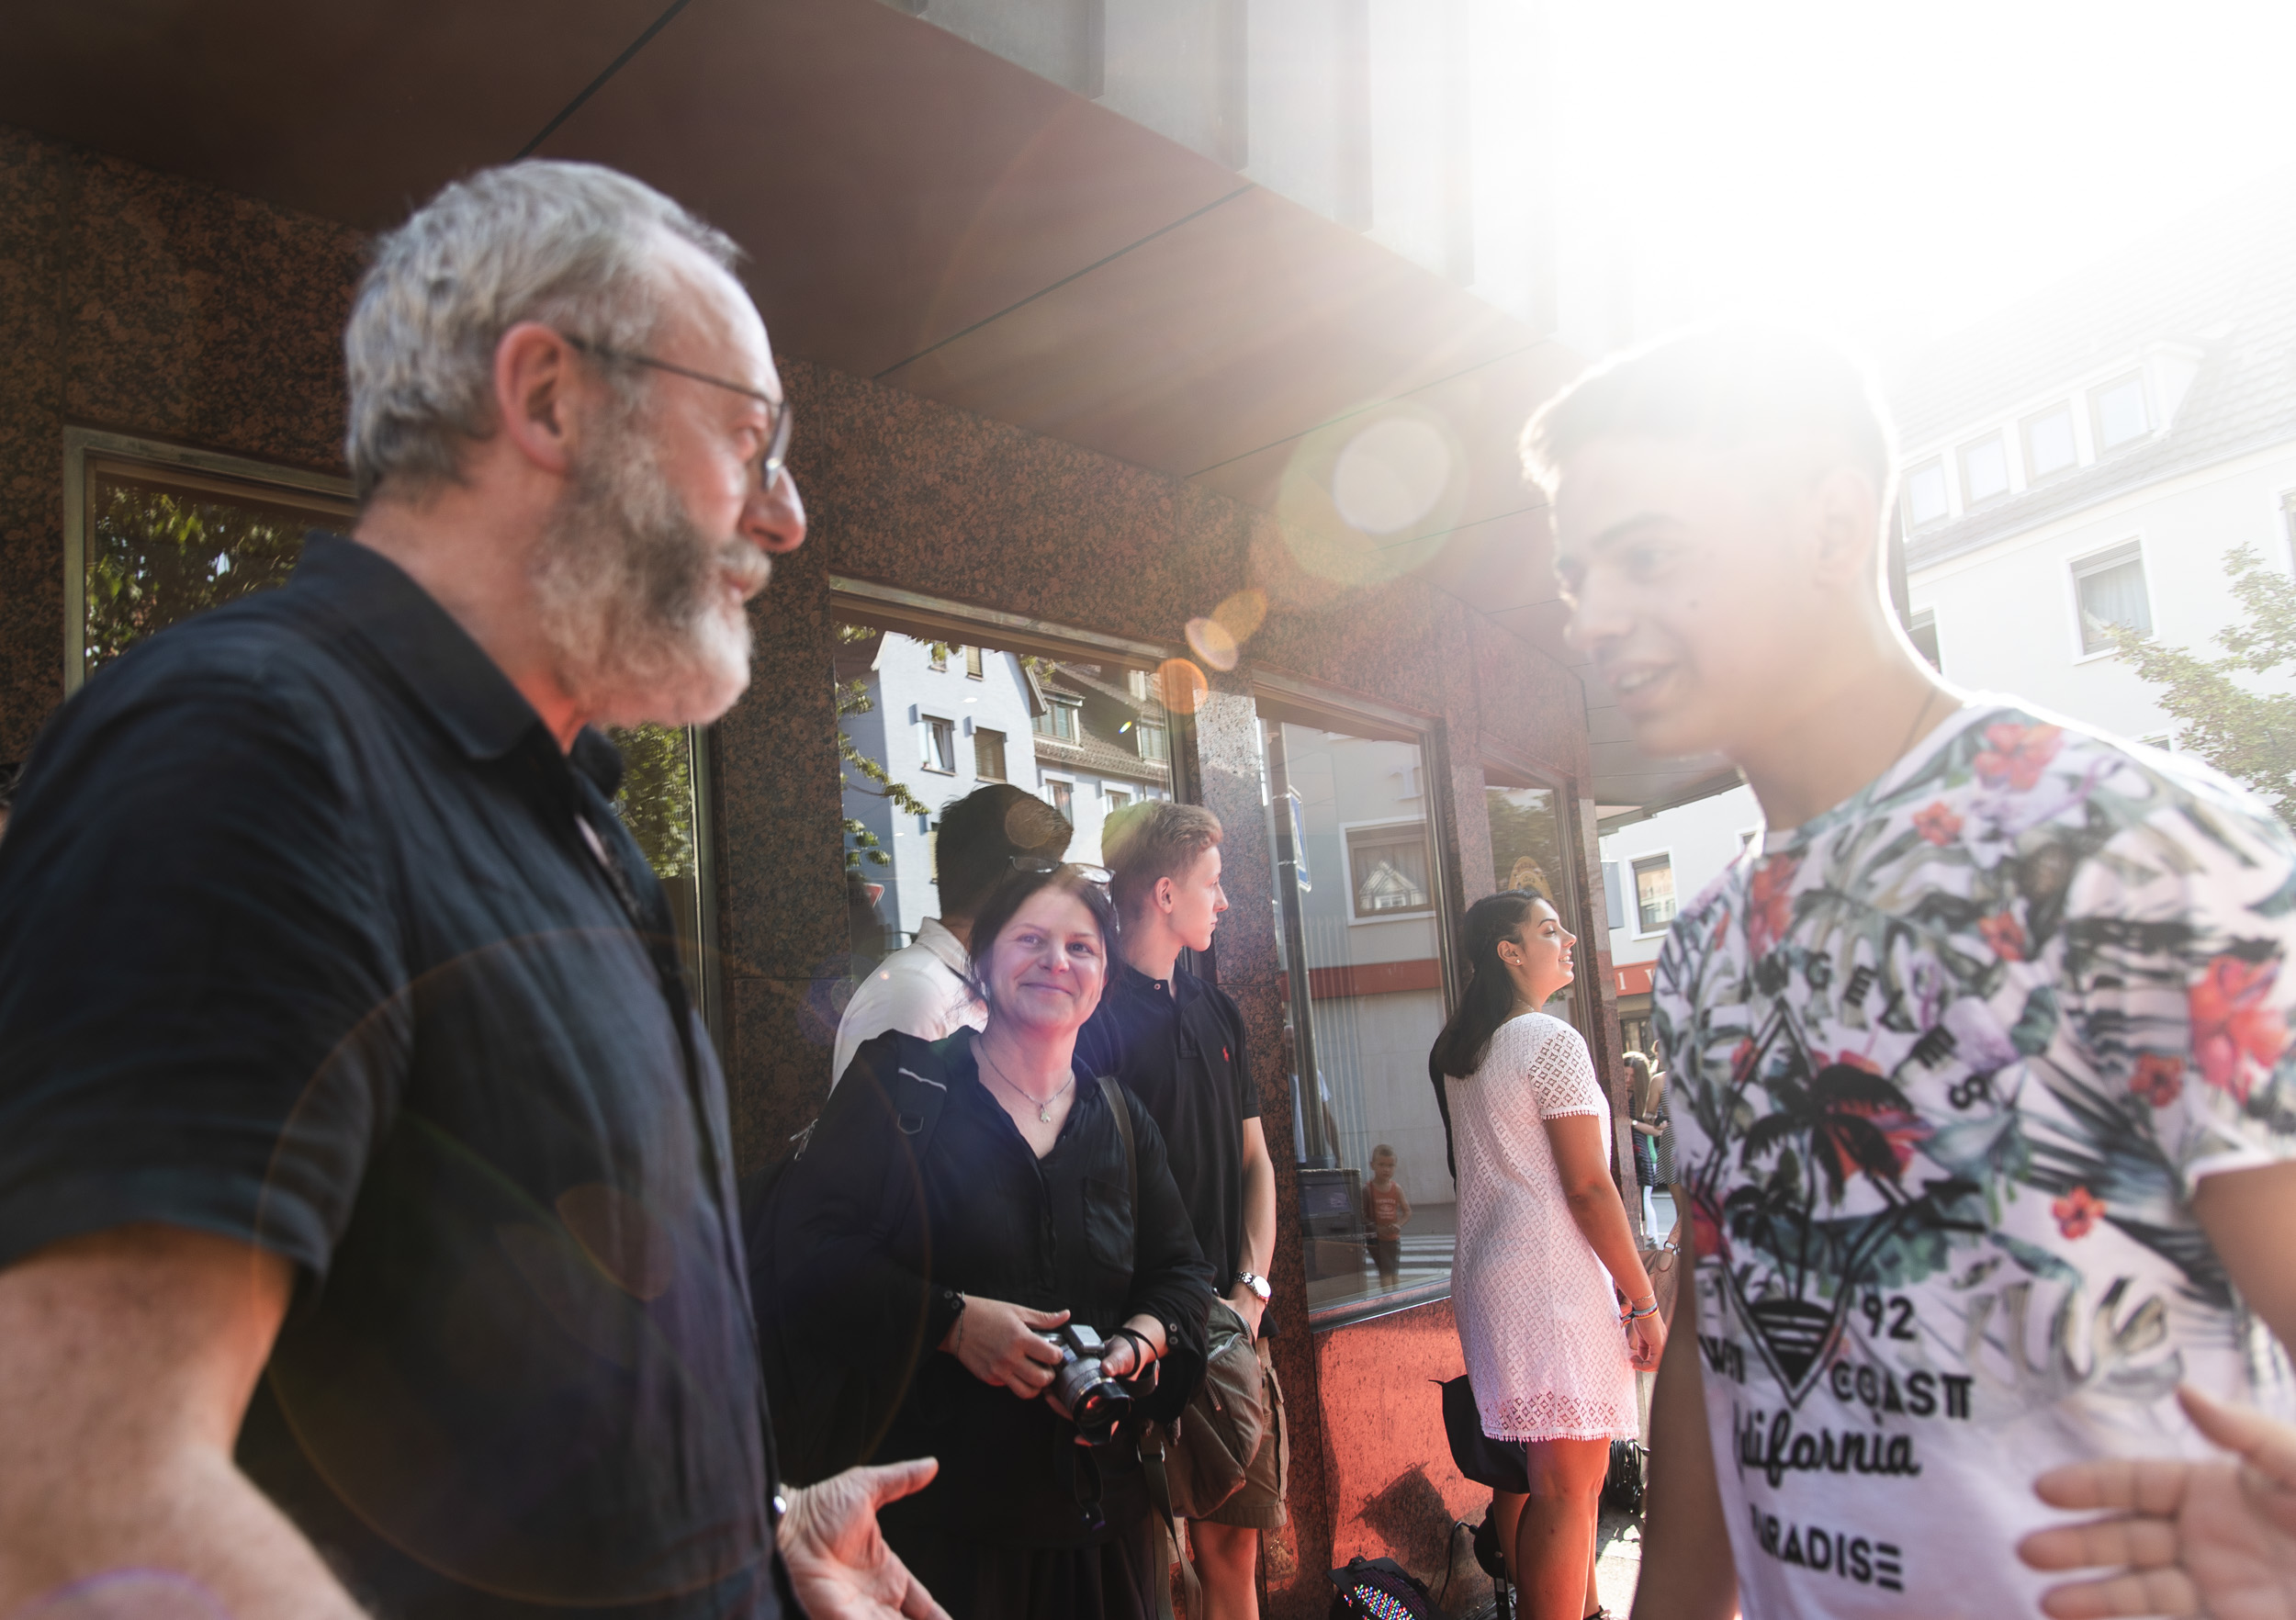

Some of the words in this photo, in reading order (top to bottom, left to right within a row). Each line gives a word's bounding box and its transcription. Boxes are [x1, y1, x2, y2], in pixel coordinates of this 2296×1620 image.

[1862, 1292, 1918, 1341] 92
[1829, 1360, 1975, 1421] COAST
[1732, 1399, 1922, 1490] lifornia
